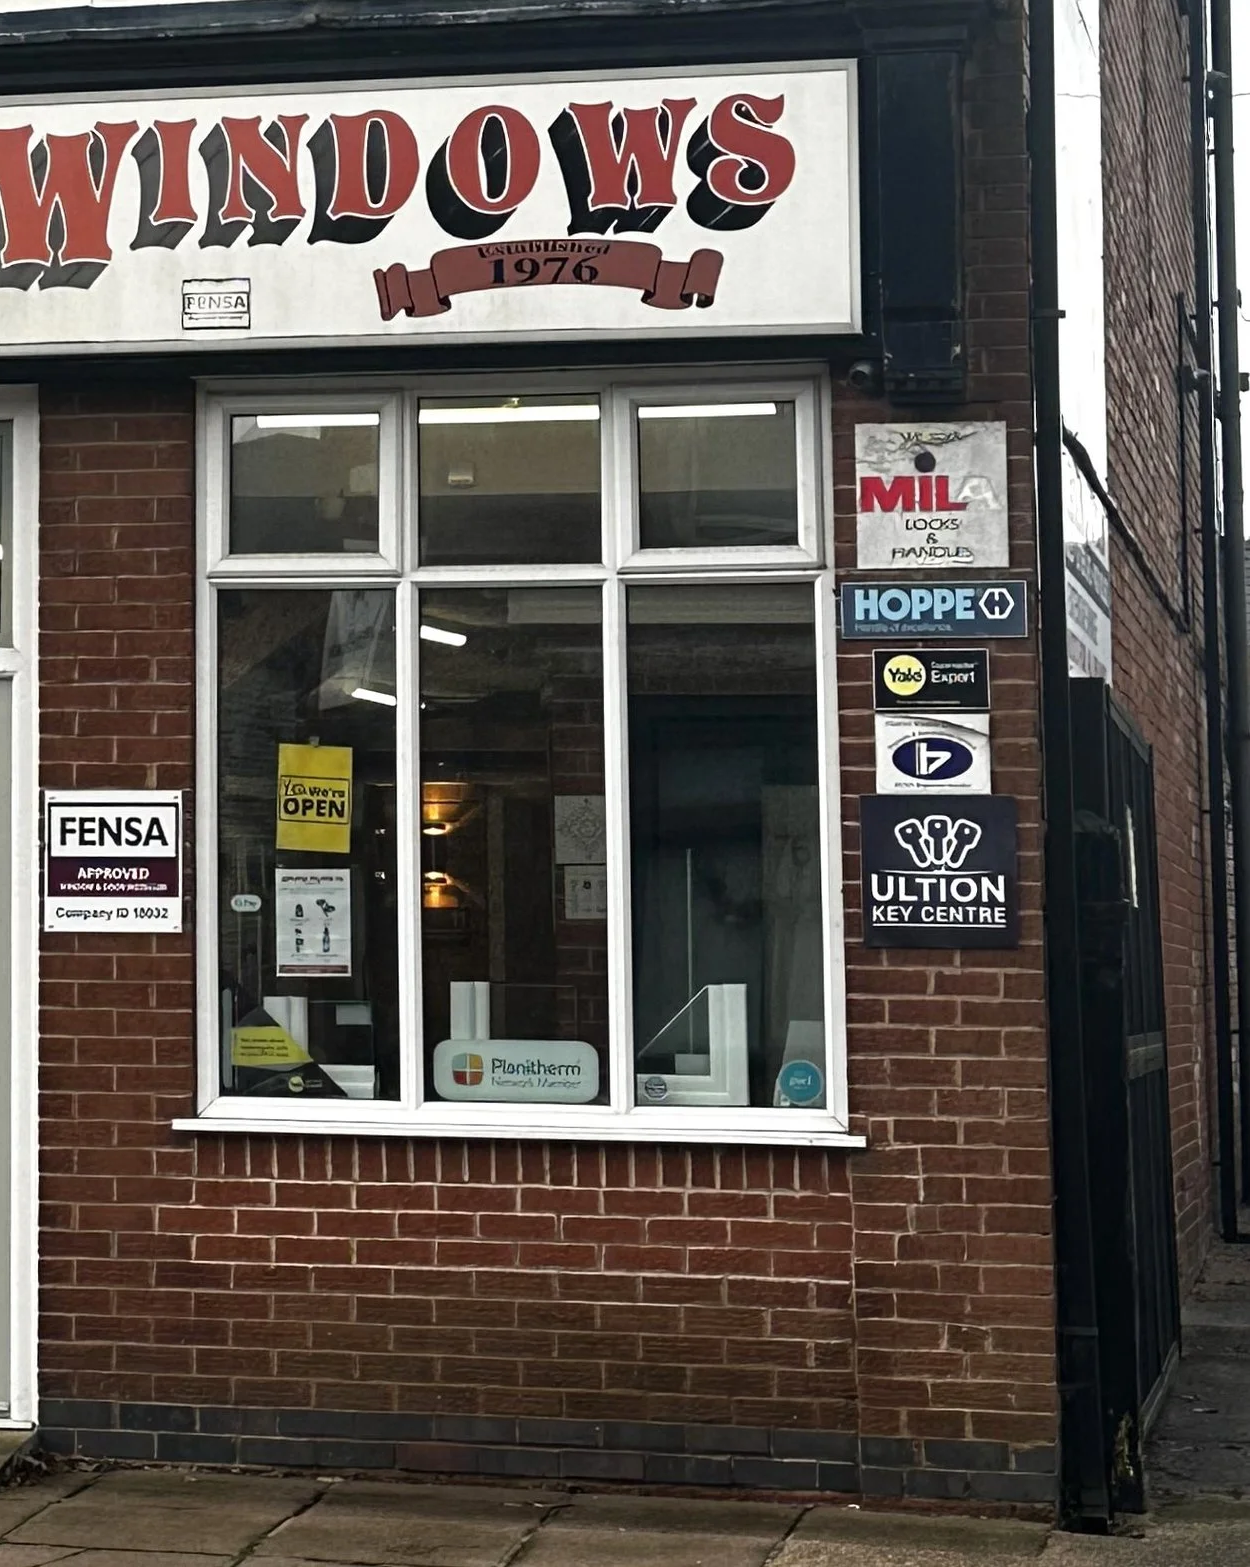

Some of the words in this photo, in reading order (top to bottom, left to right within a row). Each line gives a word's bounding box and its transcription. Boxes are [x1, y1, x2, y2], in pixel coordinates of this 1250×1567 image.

[490, 256, 599, 284] 1976
[854, 588, 976, 621] HOPPE
[888, 667, 923, 683] Yale
[283, 798, 345, 818] OPEN
[60, 817, 169, 847] FENSA
[77, 867, 150, 880] APPROVED
[871, 874, 1006, 903] ULTION
[872, 905, 913, 922] KEY
[921, 906, 1007, 923] CENTRE
[491, 1058, 581, 1076] Planitherm
